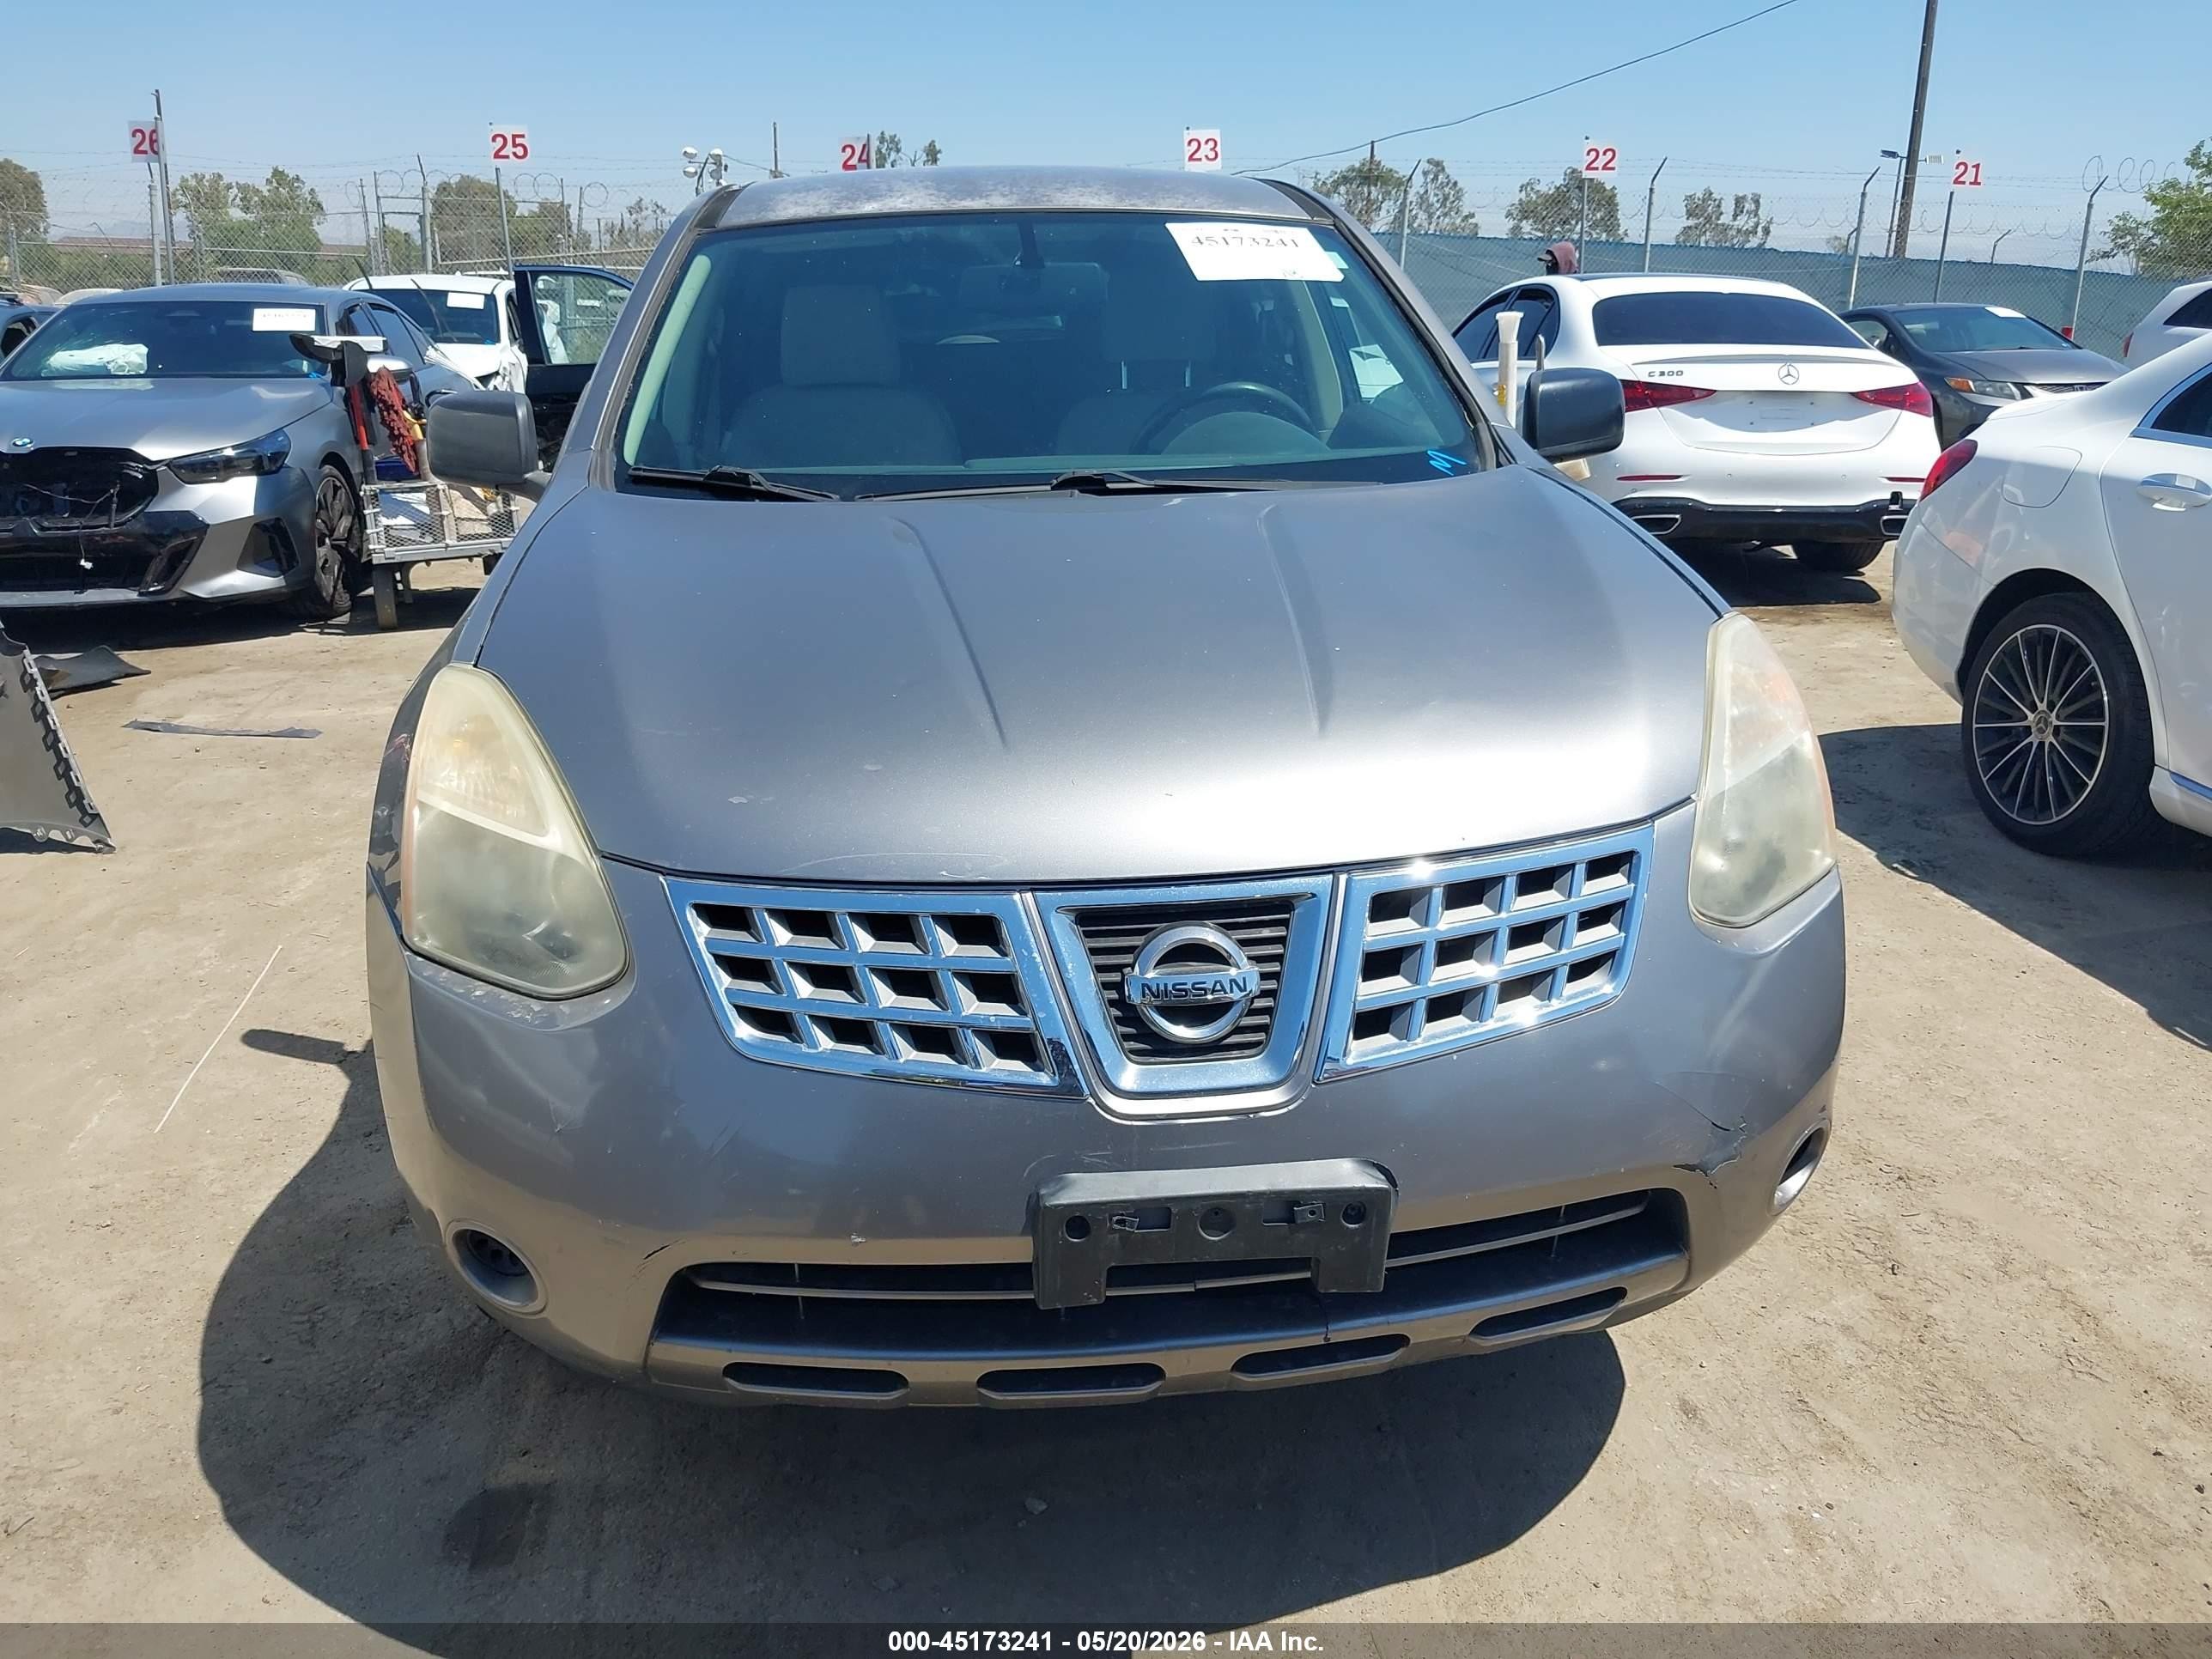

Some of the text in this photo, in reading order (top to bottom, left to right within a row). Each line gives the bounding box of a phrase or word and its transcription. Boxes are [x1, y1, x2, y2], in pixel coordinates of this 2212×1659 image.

[131, 129, 159, 155] 26
[491, 133, 529, 160] 25
[1187, 137, 1218, 161] 23
[842, 143, 871, 171] 24
[1584, 148, 1617, 171] 22
[1953, 161, 1982, 185] 21
[1190, 235, 1299, 248] 45173241
[1140, 975, 1247, 1000] NISSAN
